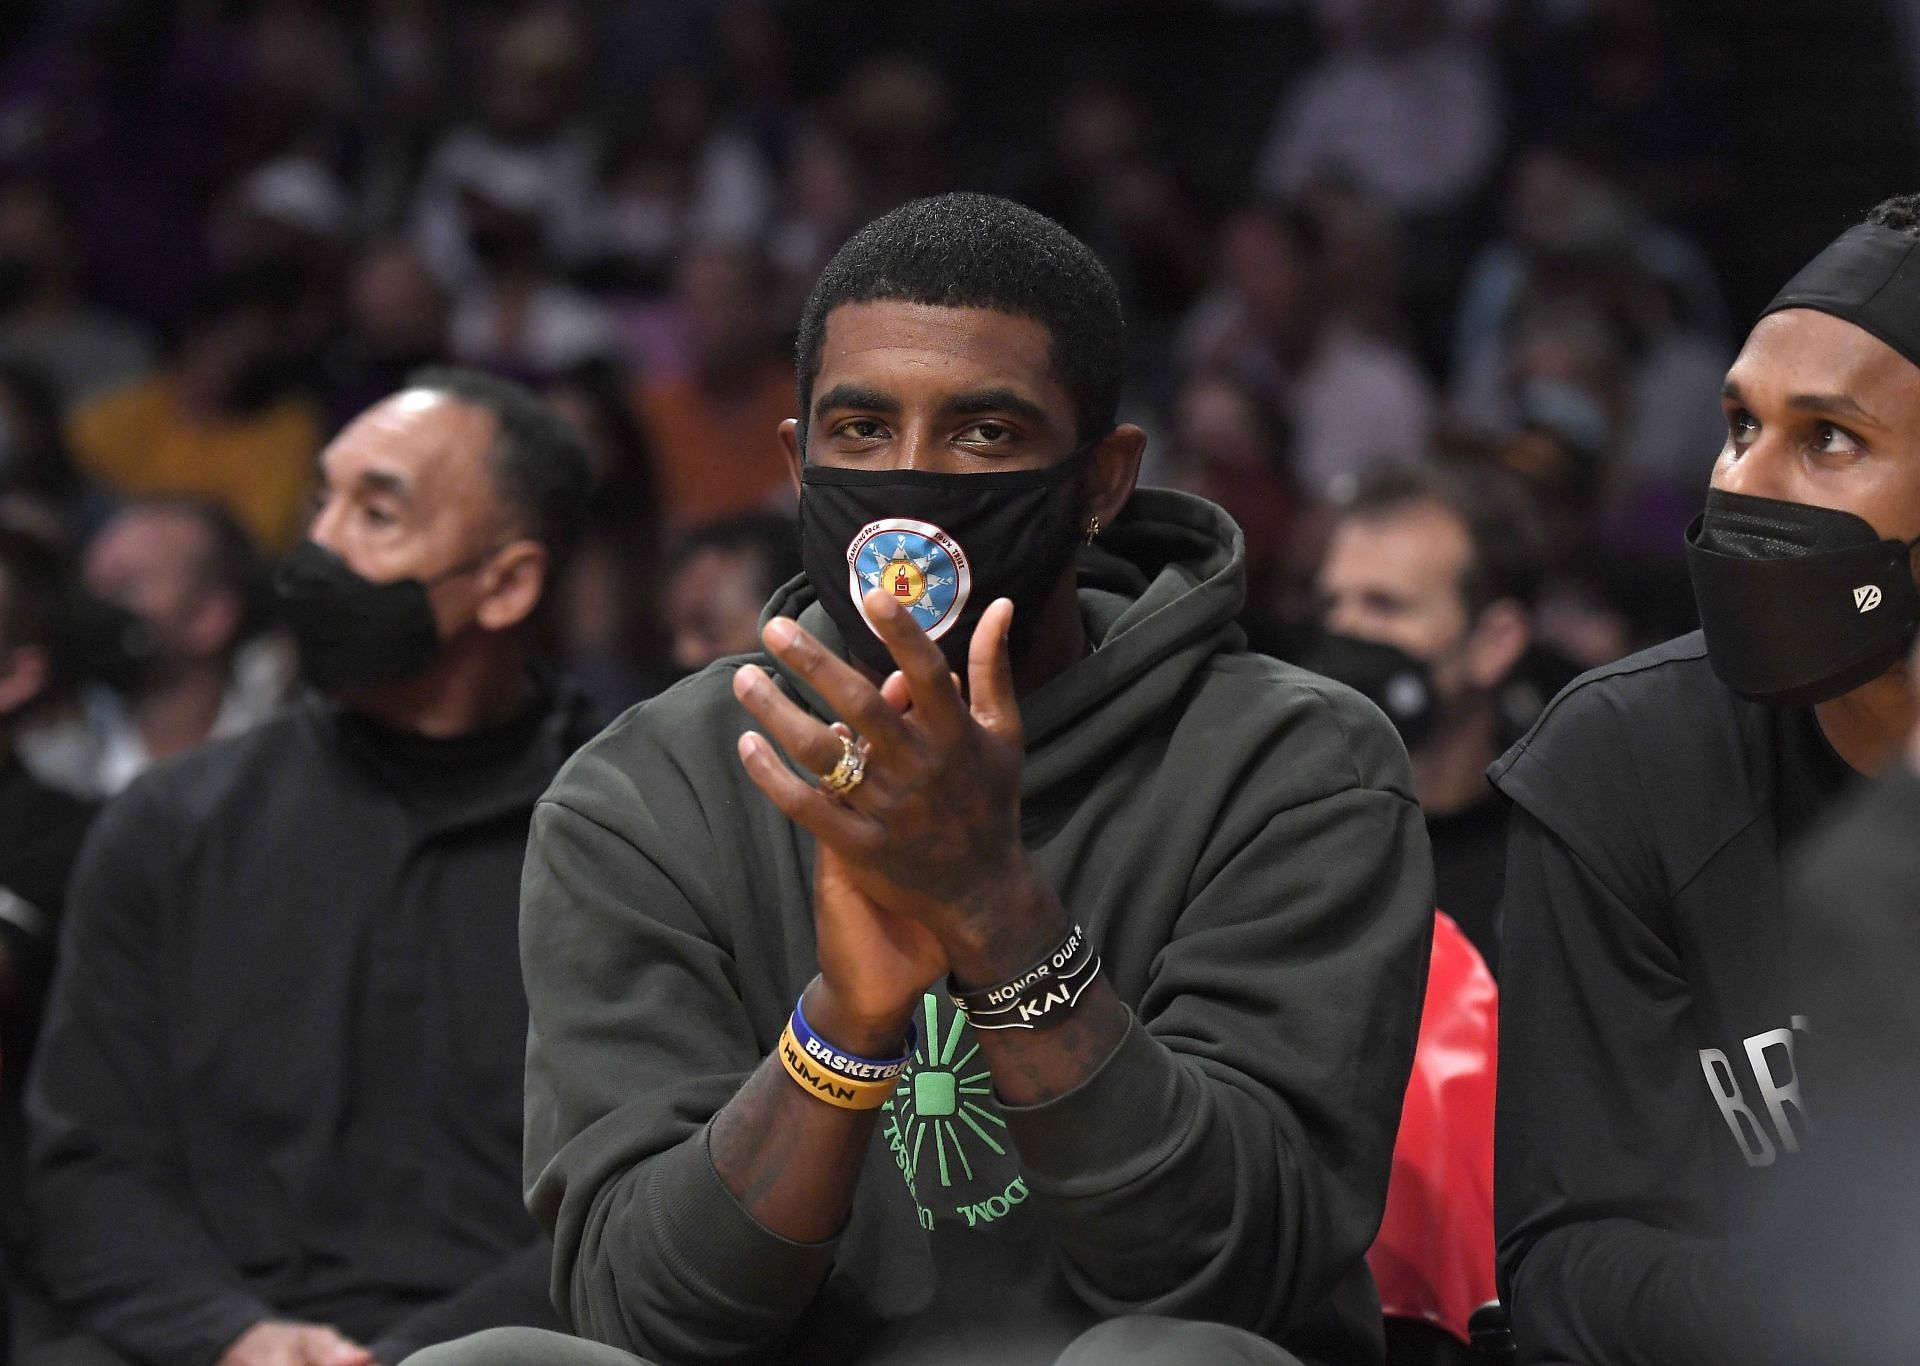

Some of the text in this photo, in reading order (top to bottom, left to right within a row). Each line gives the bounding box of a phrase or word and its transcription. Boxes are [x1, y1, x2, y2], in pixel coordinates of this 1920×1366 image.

[864, 523, 880, 535] ROCK
[987, 964, 1050, 1005] HONOR
[1052, 935, 1080, 969] OUR
[1018, 983, 1071, 1022] KAI
[783, 1041, 857, 1101] HUMAN
[805, 1036, 912, 1079] BASKETBA
[1698, 1014, 1809, 1167] BR
